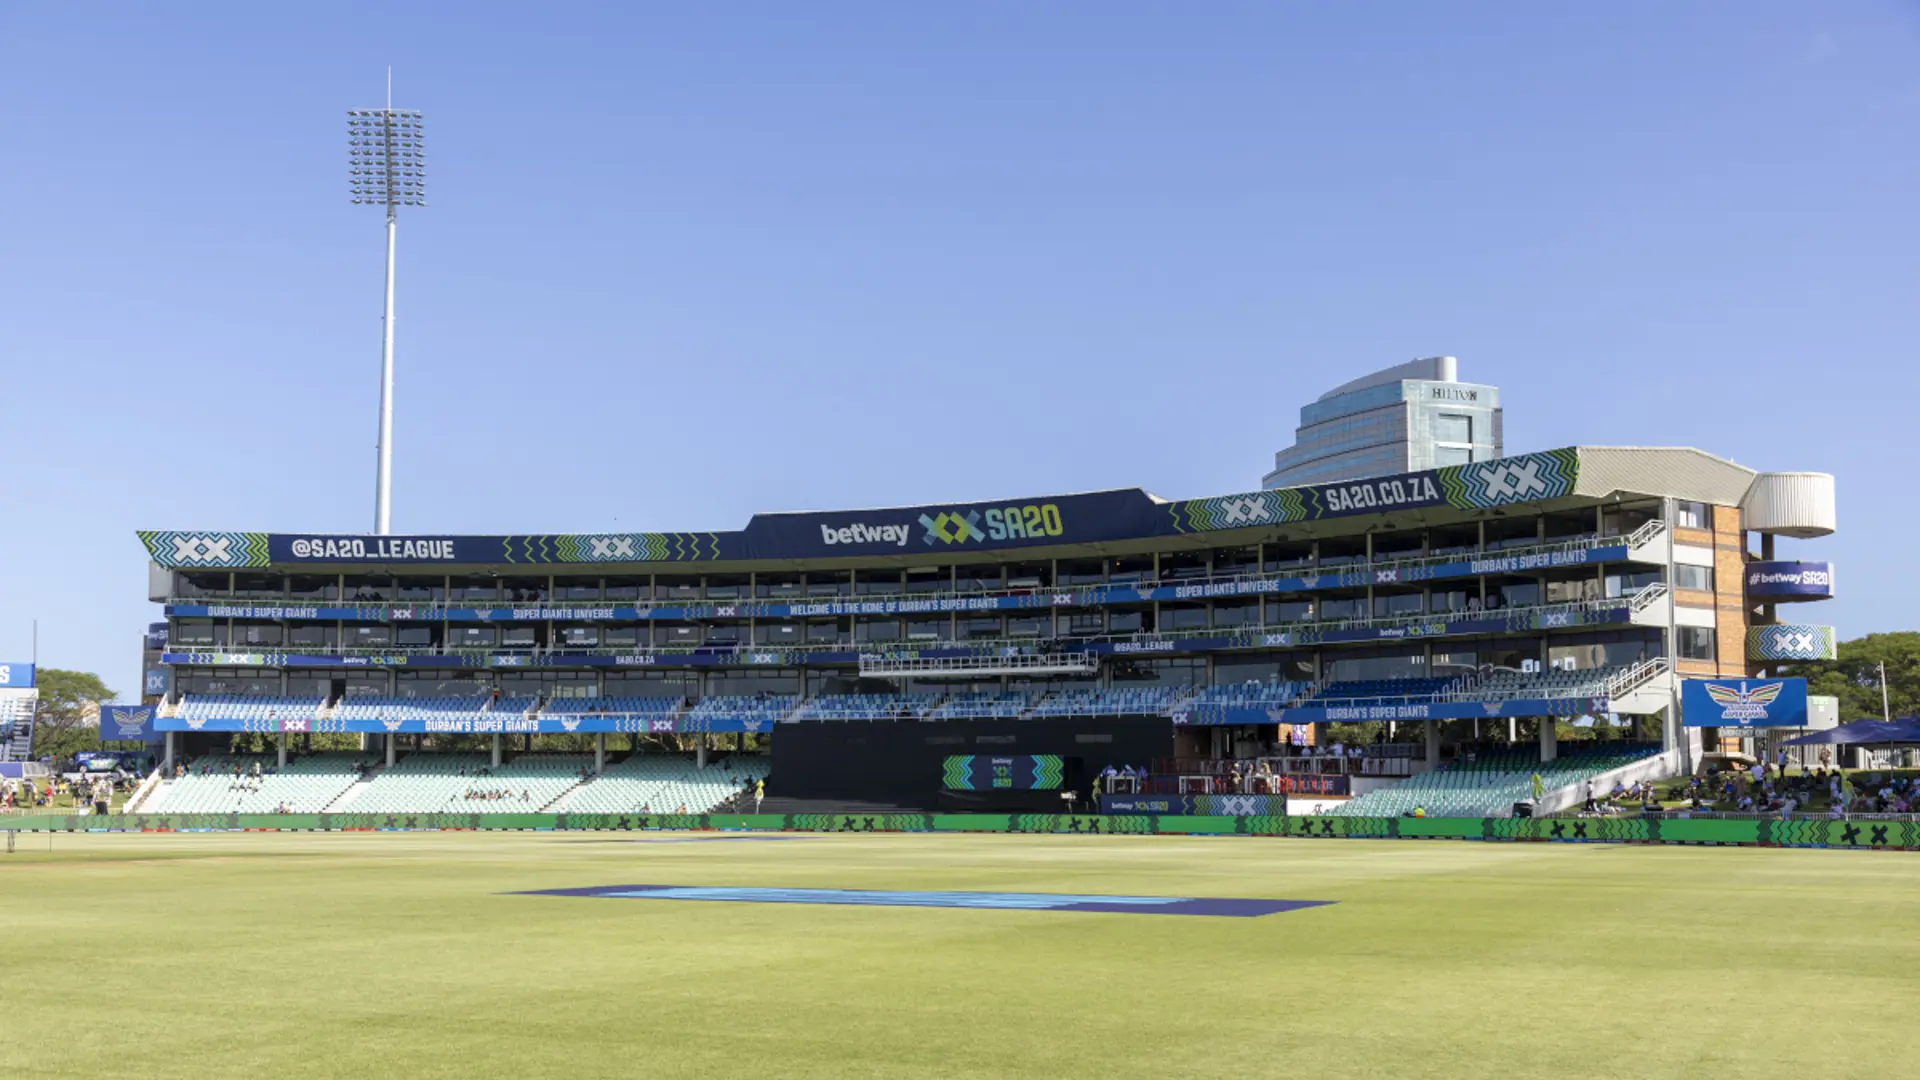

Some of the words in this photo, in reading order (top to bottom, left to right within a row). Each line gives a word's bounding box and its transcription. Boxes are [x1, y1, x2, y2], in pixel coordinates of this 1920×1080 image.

[1432, 388, 1477, 400] HILTON
[1326, 477, 1439, 511] SA20.CO.ZA
[820, 523, 909, 546] betway
[985, 504, 1063, 540] SA20
[292, 539, 455, 559] @SA20_LEAGUE
[1471, 558, 1517, 573] DURBAN'S
[1519, 553, 1549, 569] SUPER
[1552, 549, 1587, 564] GIANTS
[1803, 571, 1828, 585] SA20
[1176, 585, 1202, 597] SUPER
[1204, 583, 1235, 596] GIANTS
[1238, 580, 1280, 593] UNIVERSE
[208, 606, 252, 617] DURBAN'S
[254, 607, 283, 618] SUPER
[285, 608, 317, 618] GIANTS
[513, 609, 539, 619] SUPER
[542, 609, 572, 618] GIANTS
[574, 609, 614, 618] UNIVERSE
[790, 604, 829, 615] WELCOME
[832, 604, 842, 614] TO
[844, 603, 858, 613] THE
[862, 602, 883, 613] HOME
[886, 601, 896, 612] OF
[899, 600, 938, 611] DURBAN'S
[940, 599, 966, 610] SUPER
[968, 598, 998, 609] GIANTS
[1326, 708, 1367, 719] DURBAN'S
[1369, 707, 1396, 718] SUPER
[1398, 705, 1429, 717] GIANTS
[425, 720, 471, 731] DURBAN'S
[473, 720, 503, 731] SUPER
[505, 720, 538, 731] GIANTS
